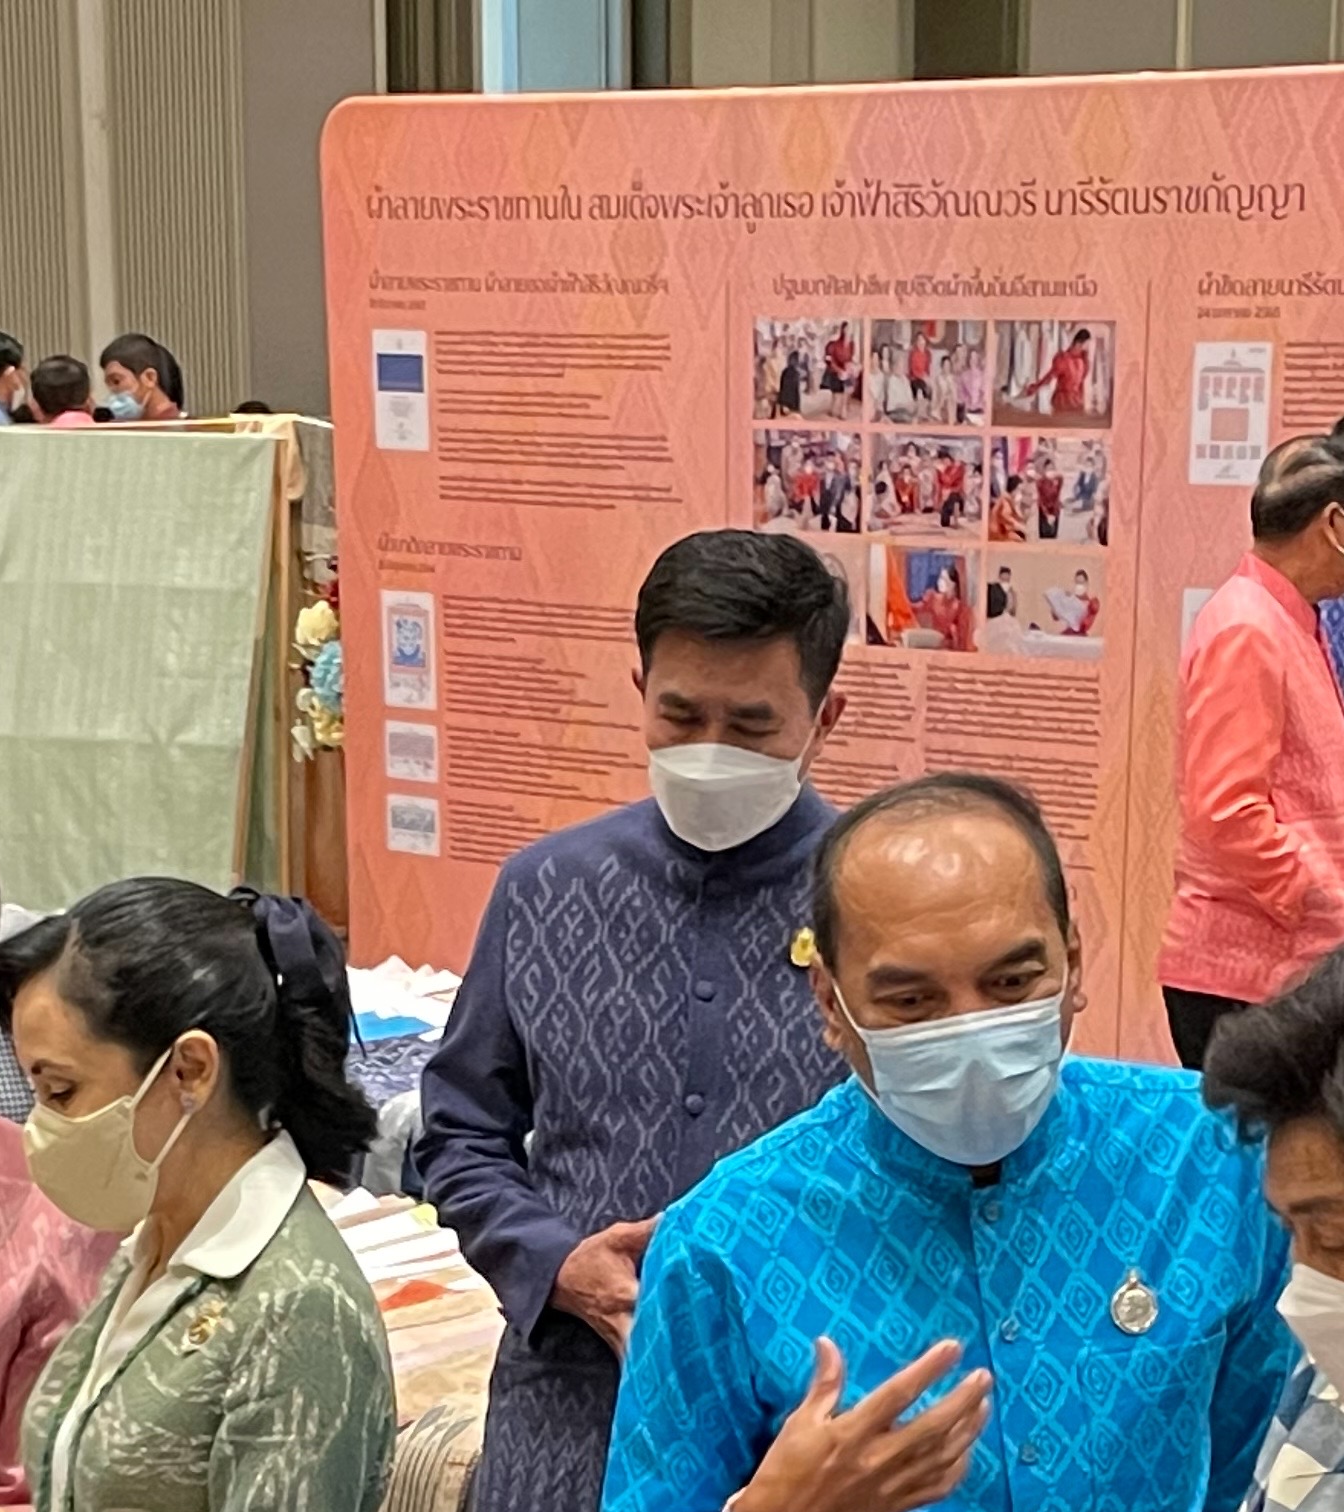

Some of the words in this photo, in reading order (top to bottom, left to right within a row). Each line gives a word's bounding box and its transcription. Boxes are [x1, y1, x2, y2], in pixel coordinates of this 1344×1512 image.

[1044, 174, 1306, 220] นารีรัตนราชกัญญา
